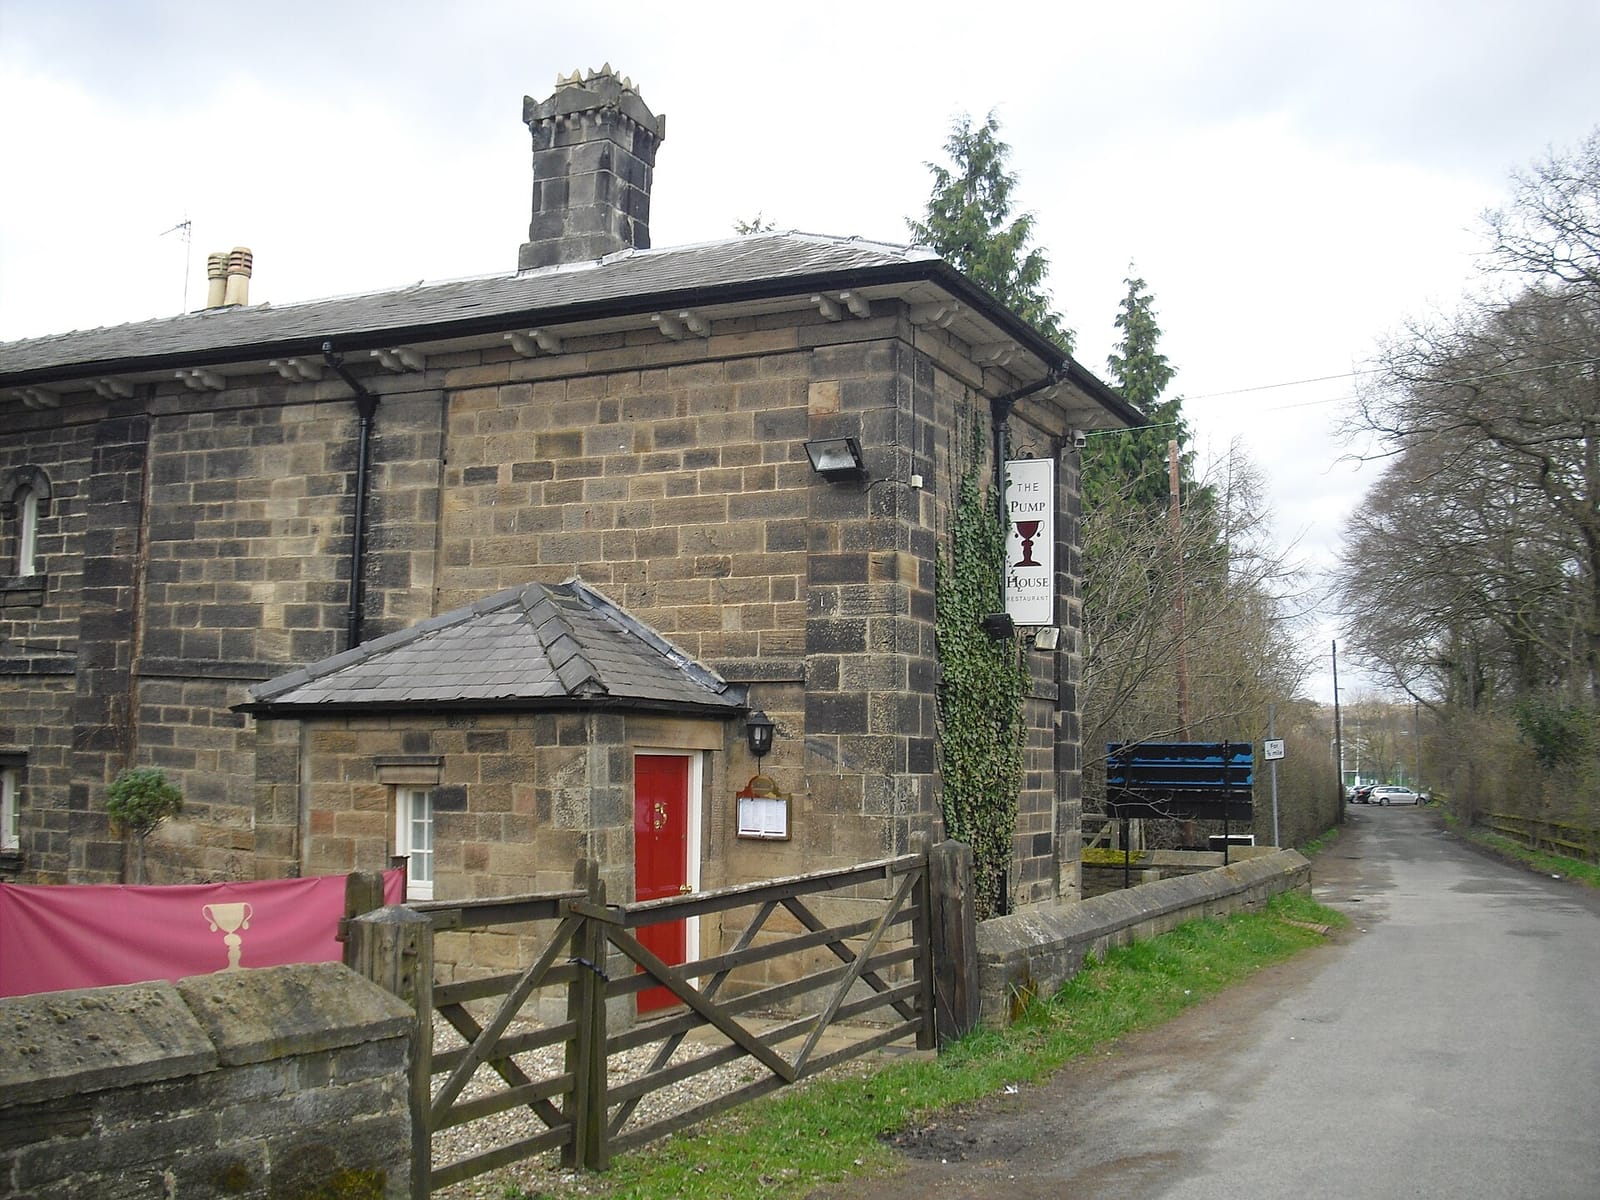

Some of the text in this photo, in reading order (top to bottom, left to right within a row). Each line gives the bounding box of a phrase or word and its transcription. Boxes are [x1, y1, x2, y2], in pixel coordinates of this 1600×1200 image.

[1017, 482, 1039, 492] THE
[1011, 500, 1046, 513] PUMP
[1007, 575, 1049, 588] HOUSE
